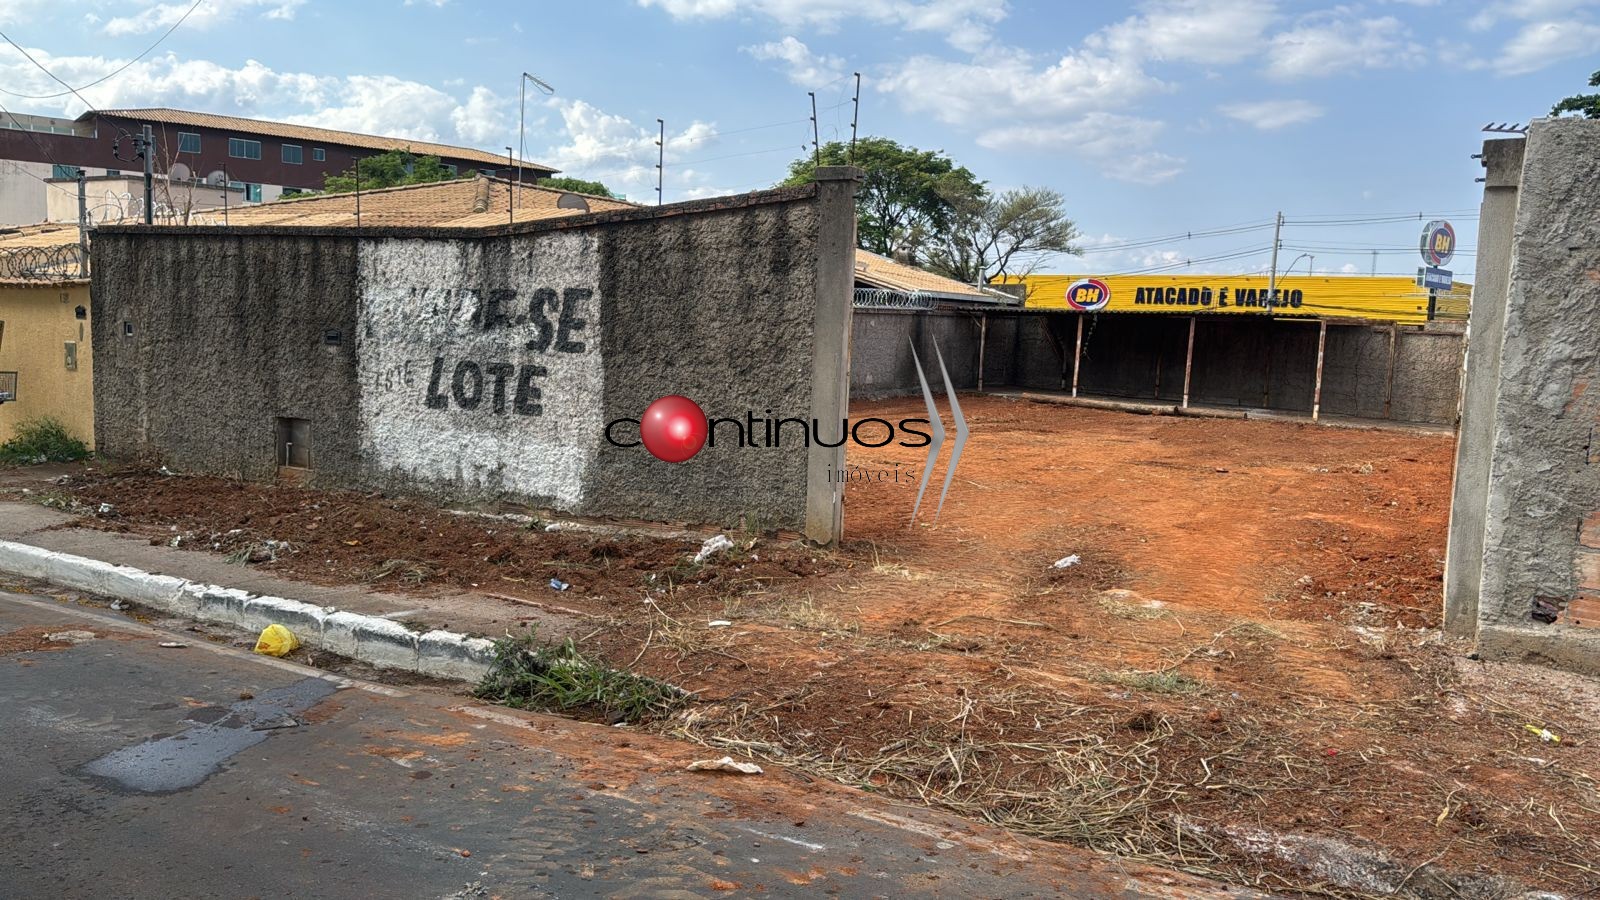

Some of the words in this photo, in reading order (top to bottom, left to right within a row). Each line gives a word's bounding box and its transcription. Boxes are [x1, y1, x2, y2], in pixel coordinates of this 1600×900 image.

[1435, 233, 1451, 253] BH
[1075, 288, 1100, 303] BH
[1135, 287, 1212, 306] ATACADO
[423, 356, 548, 417] LOTE
